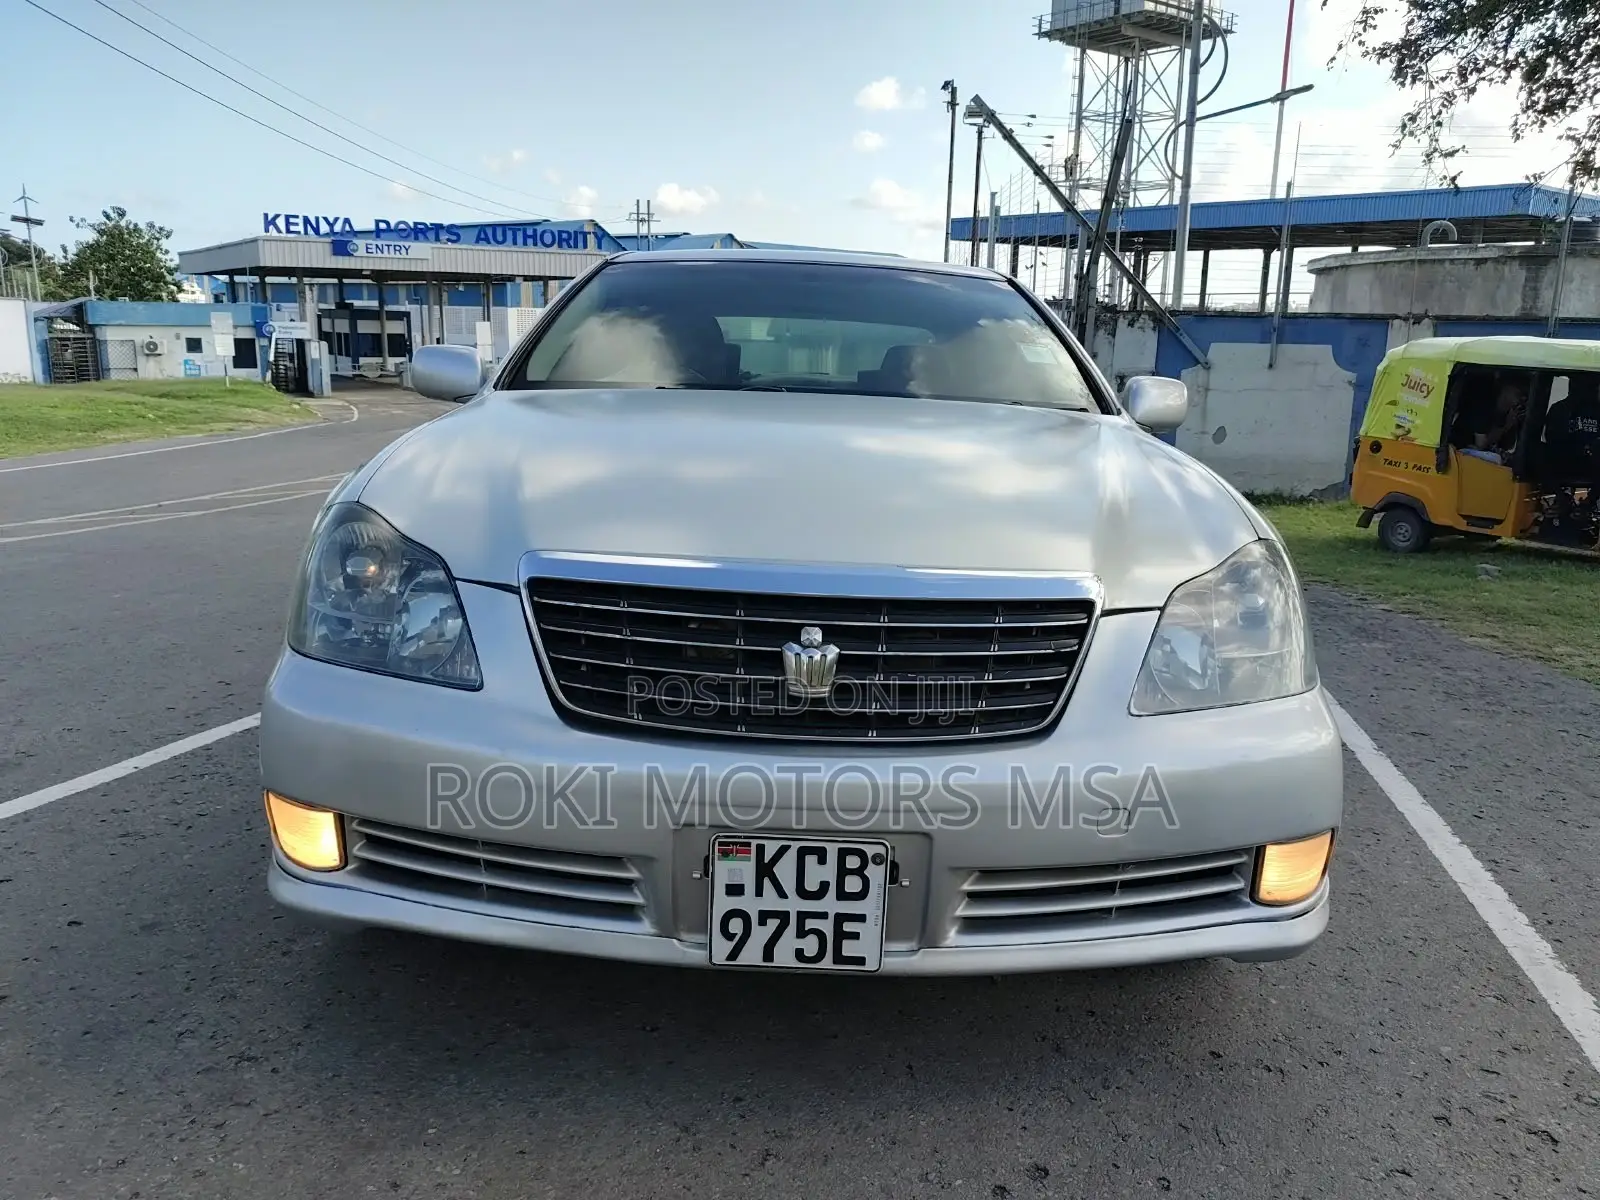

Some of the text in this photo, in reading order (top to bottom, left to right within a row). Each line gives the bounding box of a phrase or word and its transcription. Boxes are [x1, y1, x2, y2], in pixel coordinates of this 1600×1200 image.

[263, 212, 606, 250] KENYA PORTS AUTHORITY
[365, 243, 411, 256] ENTRY
[1401, 373, 1435, 398] Juicy
[1383, 458, 1432, 474] TAXI 3 PASS
[754, 843, 871, 902] KCB
[719, 908, 867, 966] 975E
